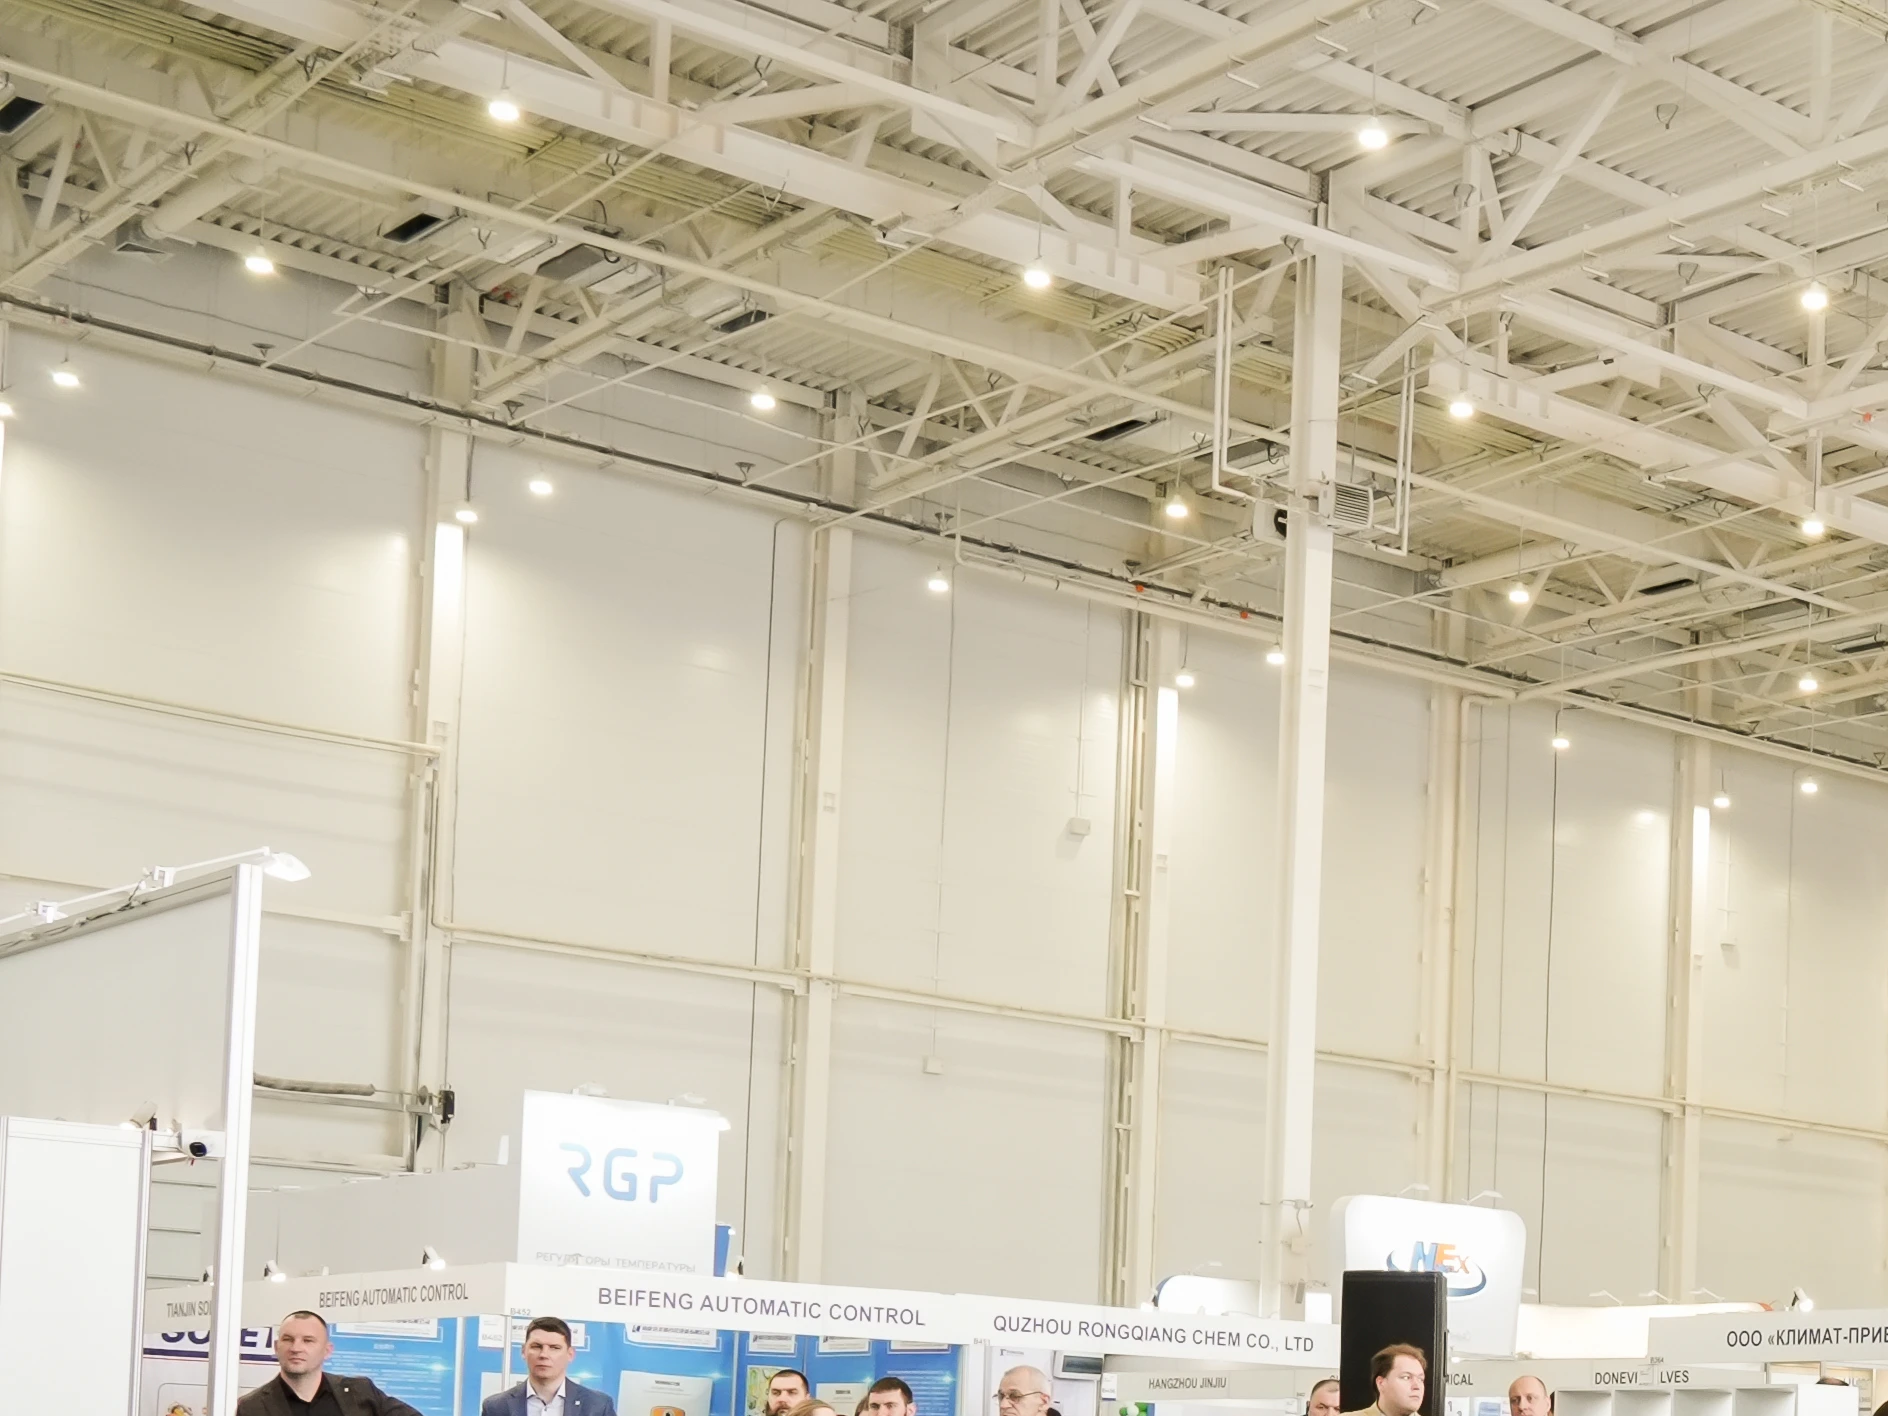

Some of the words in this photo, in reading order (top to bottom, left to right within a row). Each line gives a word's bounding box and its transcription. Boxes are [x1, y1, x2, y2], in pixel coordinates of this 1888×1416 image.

[559, 1142, 684, 1204] RGP
[616, 1257, 696, 1273] ТЕМПЕРАТУРЫ
[319, 1291, 360, 1308] BEIFENG
[361, 1285, 418, 1305] AUTOMATIC
[420, 1282, 468, 1302] CONTROL
[167, 1302, 196, 1318] TIANJIN
[598, 1287, 694, 1311] BEIFENG
[700, 1294, 822, 1320] AUTOMATIC
[828, 1303, 926, 1327] CONTROL
[993, 1315, 1072, 1337] QUZHOU
[1078, 1320, 1187, 1345] RONGQIANG
[1192, 1329, 1241, 1348] CHEM
[1284, 1336, 1314, 1353] LTD
[1727, 1330, 1762, 1348] ООО
[1149, 1378, 1198, 1391] HANGZHOU
[1200, 1376, 1228, 1389] JINJIU
